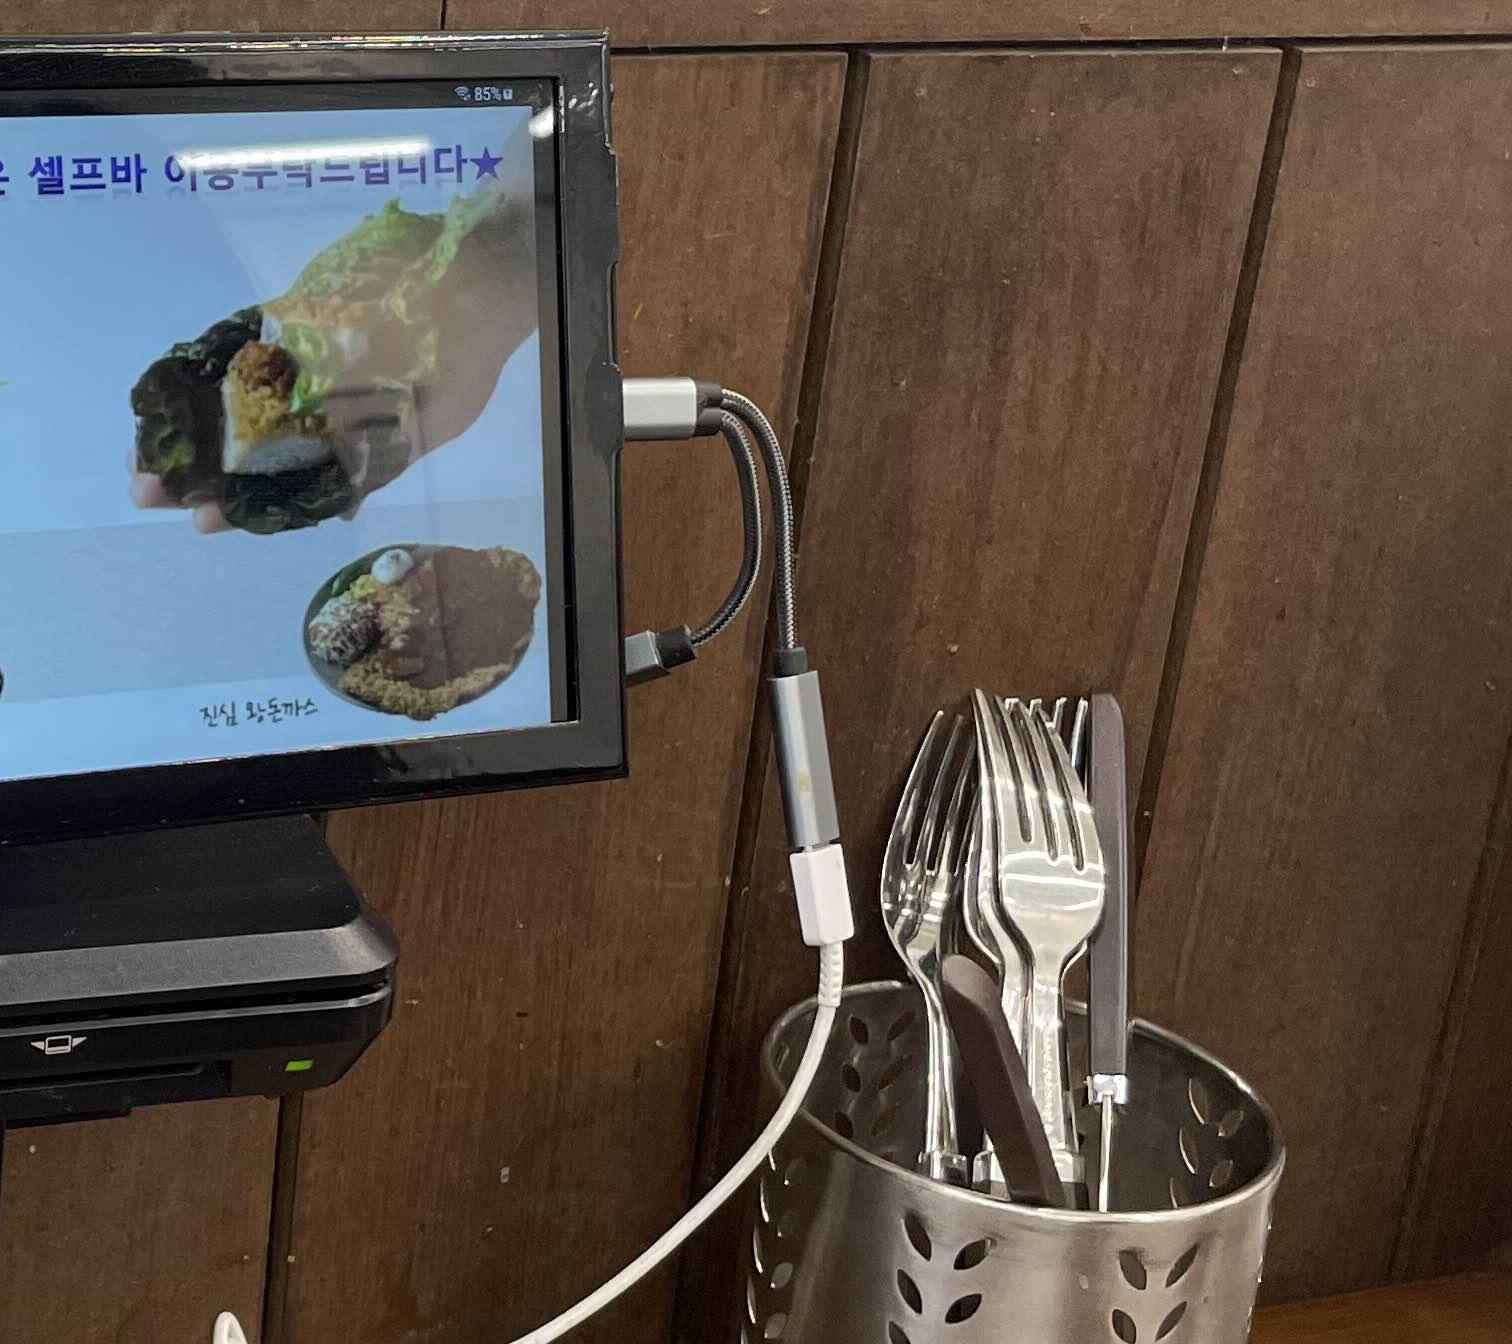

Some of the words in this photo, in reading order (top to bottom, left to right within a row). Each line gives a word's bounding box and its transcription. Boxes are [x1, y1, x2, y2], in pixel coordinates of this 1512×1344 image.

[474, 86, 502, 101] 85%
[28, 152, 147, 196] 셀프바
[199, 700, 239, 727] 진심
